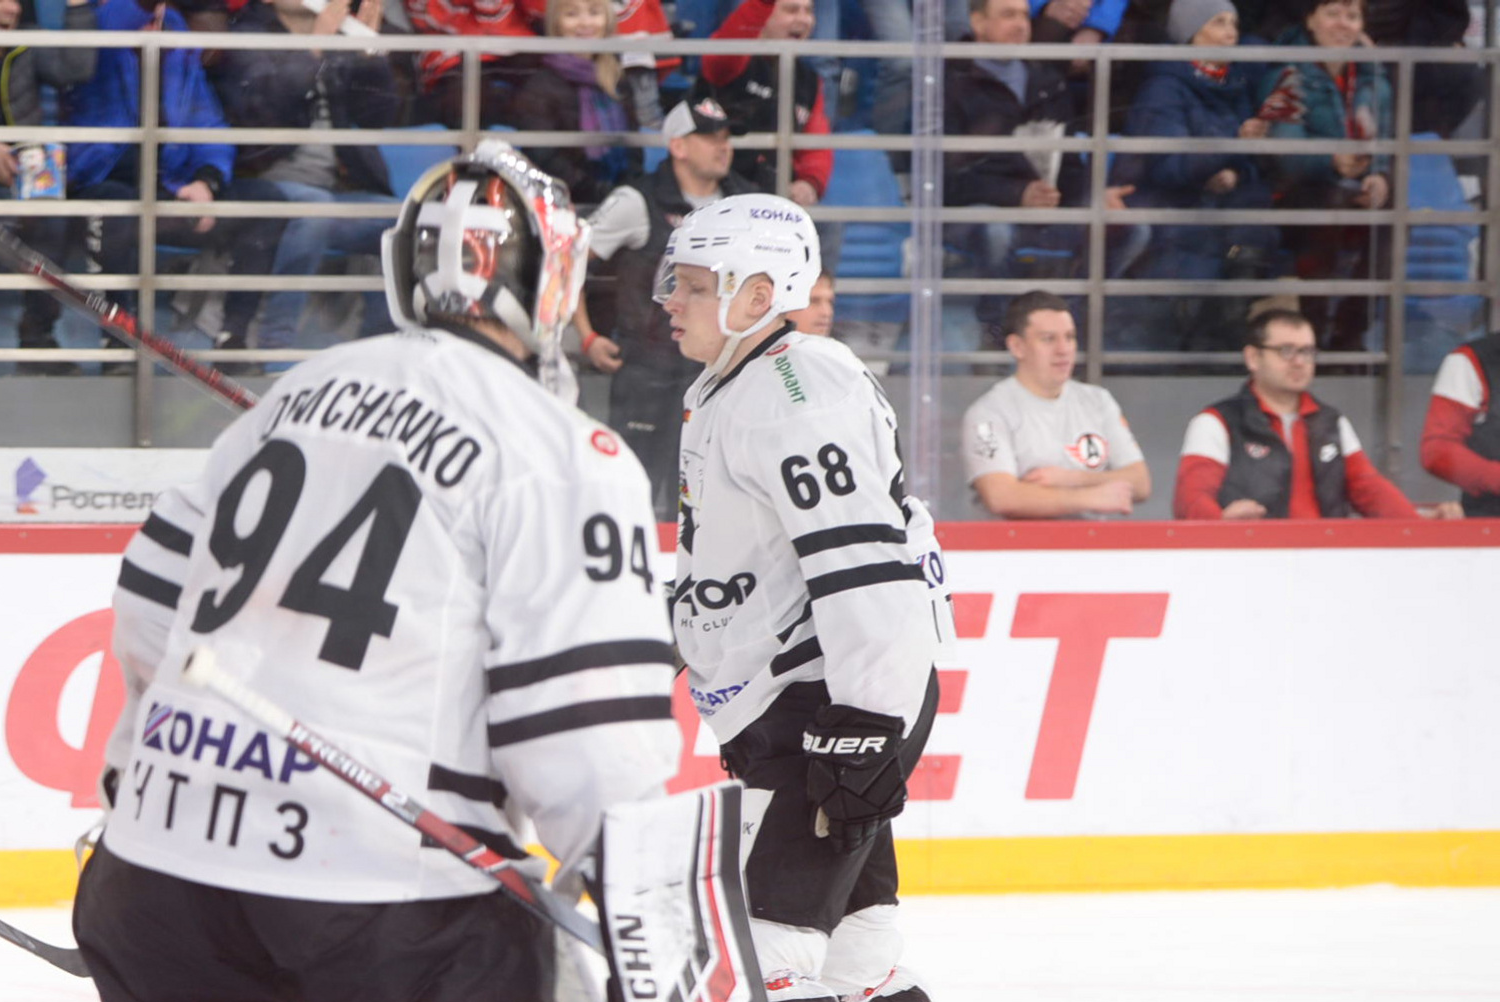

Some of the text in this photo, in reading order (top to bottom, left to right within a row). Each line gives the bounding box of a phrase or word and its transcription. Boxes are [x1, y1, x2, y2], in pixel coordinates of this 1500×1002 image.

[780, 443, 857, 510] 68
[191, 438, 422, 671] 94
[582, 513, 653, 593] 94
[143, 702, 322, 784] КОНАР
[133, 760, 309, 861] ЧТПЗ
